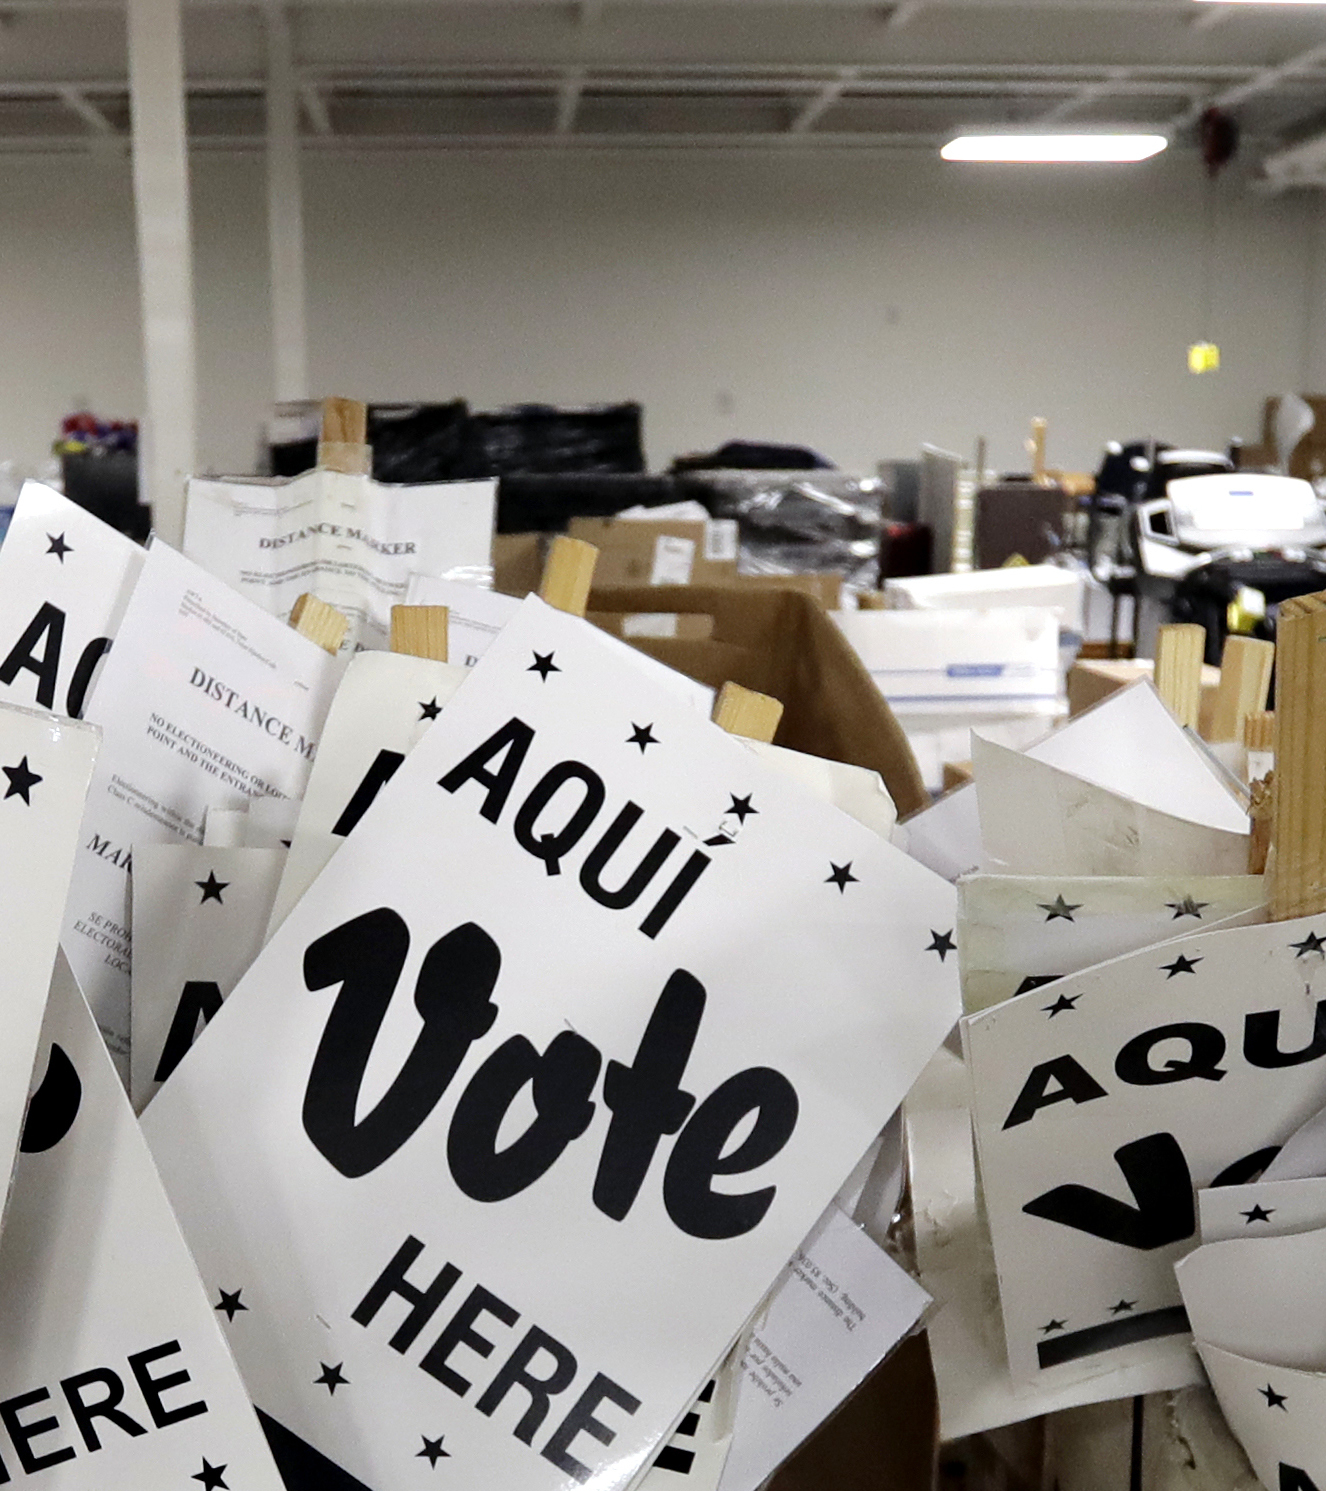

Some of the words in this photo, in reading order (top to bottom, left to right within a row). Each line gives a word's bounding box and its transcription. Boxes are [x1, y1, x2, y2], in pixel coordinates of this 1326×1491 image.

[259, 522, 342, 550] DISTANCE
[189, 667, 294, 746] DISTANCE
[147, 725, 177, 750] POINT
[179, 747, 199, 763] AND
[200, 758, 219, 776] THE
[149, 712, 165, 728] NO
[167, 721, 250, 780] ELECTIONEERING
[437, 717, 736, 940] AQUÍ
[88, 912, 103, 926] SE
[303, 907, 799, 1240] Vote
[350, 1234, 642, 1485] HERE
